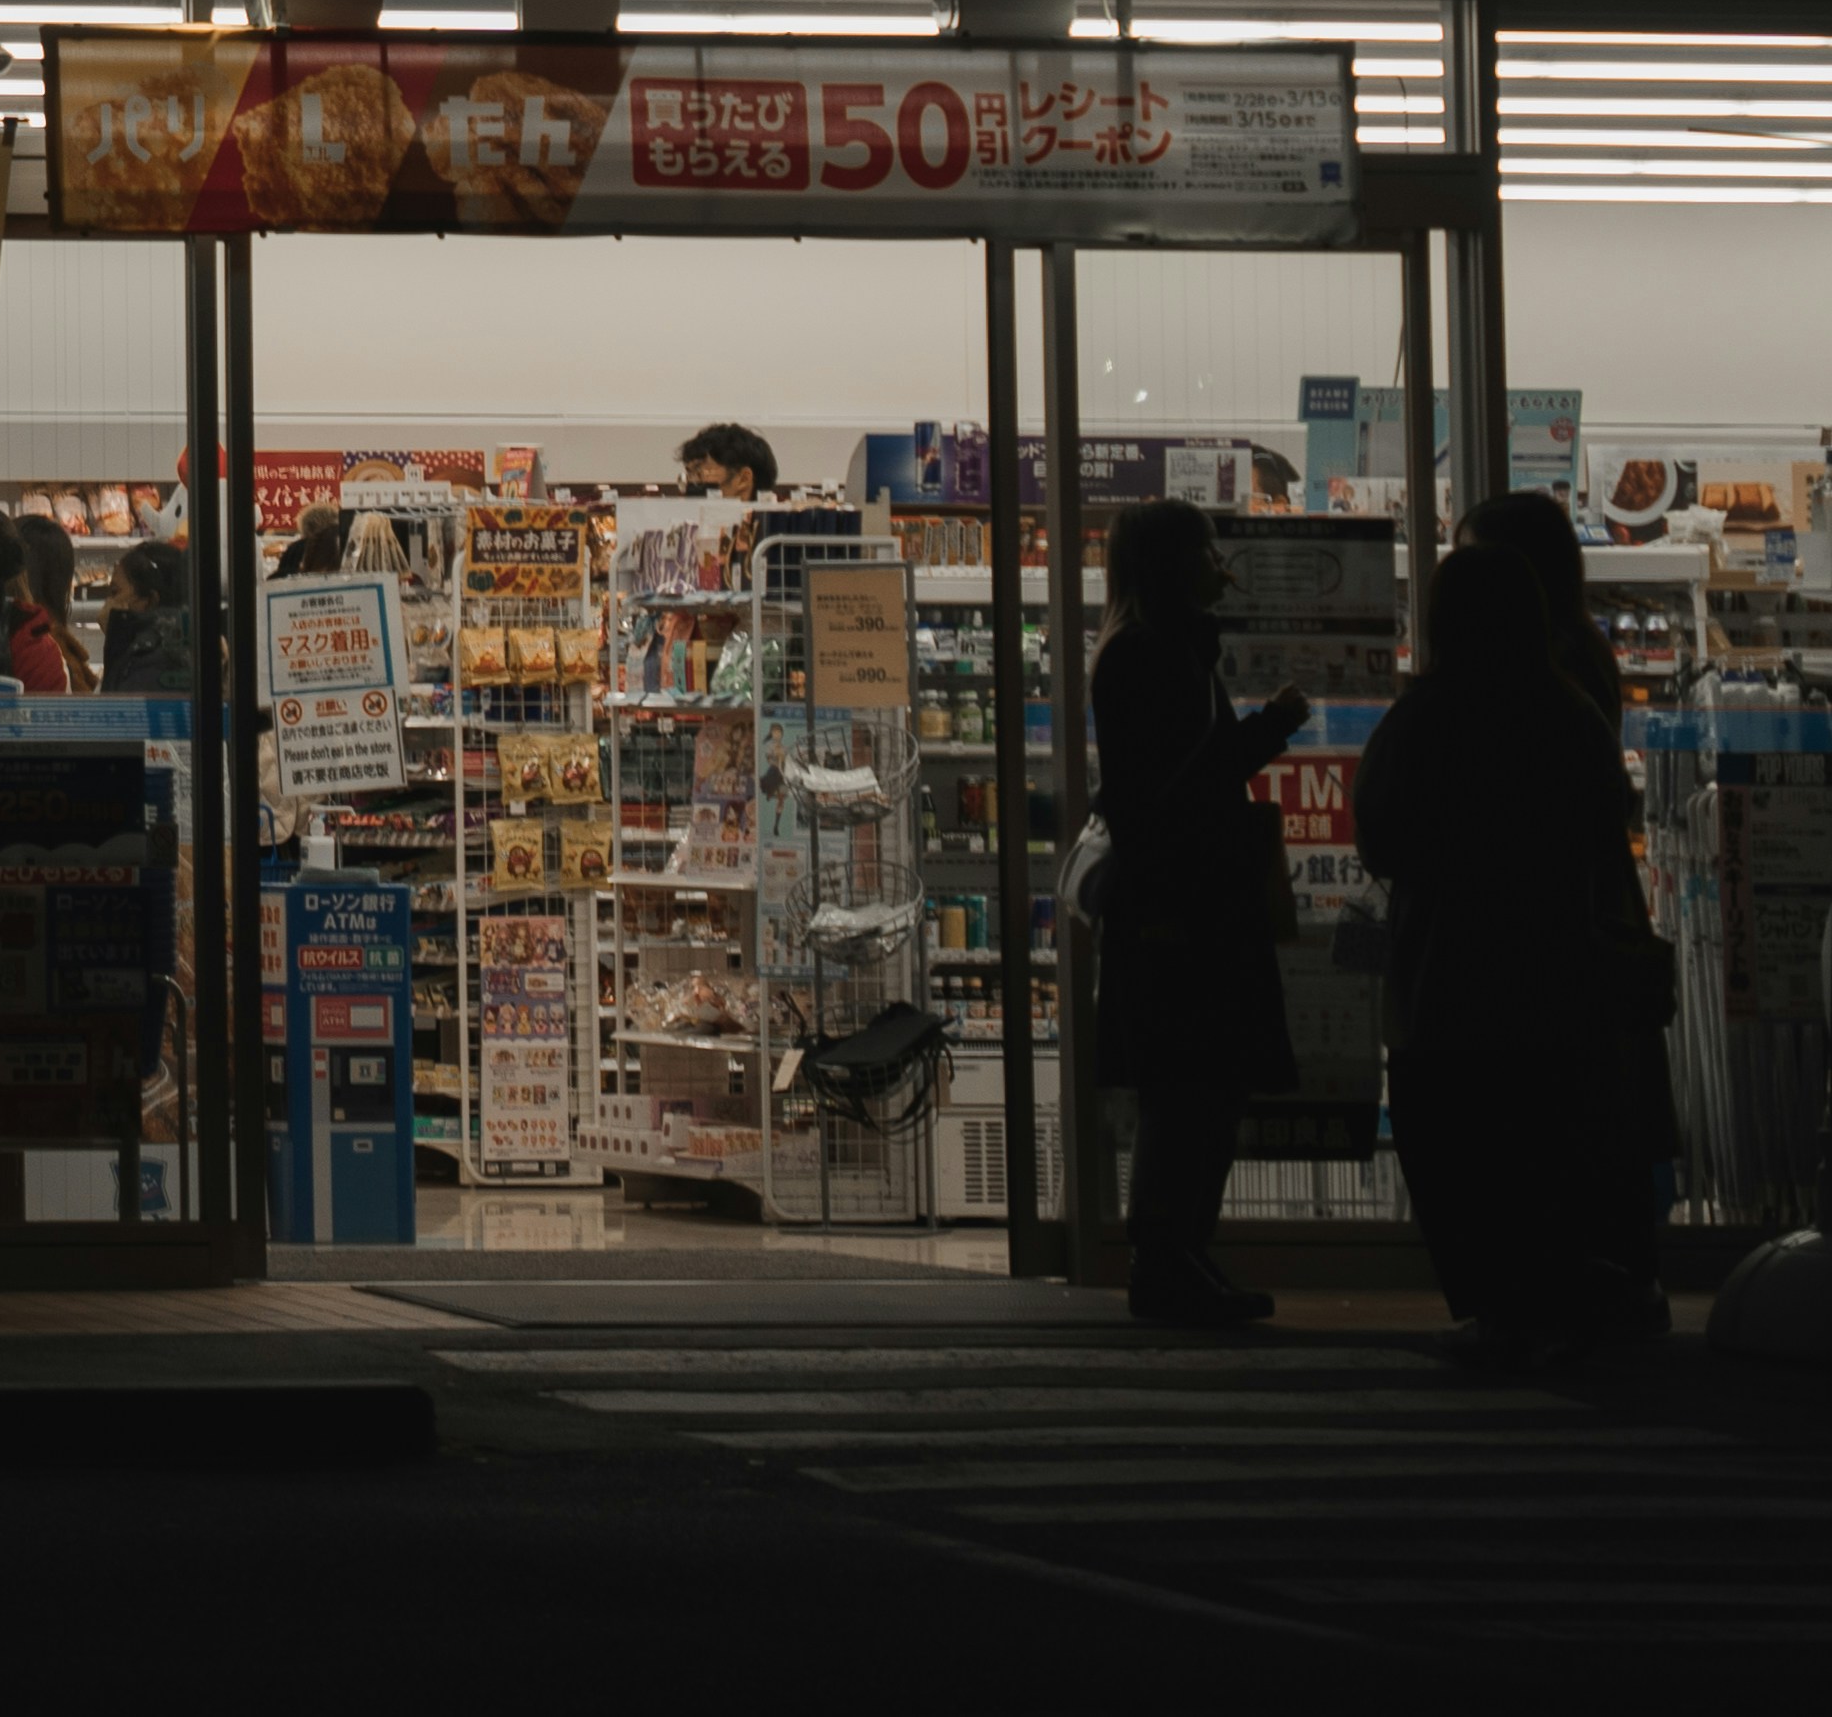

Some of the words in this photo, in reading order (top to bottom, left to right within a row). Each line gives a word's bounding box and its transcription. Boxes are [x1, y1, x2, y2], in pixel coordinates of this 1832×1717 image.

[645, 88, 792, 131] 買うたび
[1020, 81, 1169, 121] レシート
[87, 94, 204, 164] パリ
[439, 96, 576, 169] たん
[820, 81, 970, 191] 50
[1023, 124, 1172, 166] クーポン
[649, 138, 792, 177] もらえる
[1309, 388, 1349, 399] BEAMS
[1309, 401, 1349, 412] DESIGN
[476, 530, 576, 552] 素材のお菓子
[316, 699, 347, 712] お願い
[284, 749, 309, 764] Please
[311, 745, 331, 760] don't
[331, 747, 344, 759] eat
[346, 744, 353, 756] in
[355, 743, 368, 755] the
[370, 742, 394, 755] store.
[292, 762, 390, 785] 请不要在商店吃饭
[1283, 813, 1332, 840] 店舗
[304, 893, 396, 912] ローソン銀行
[324, 913, 377, 930] ATMは
[303, 950, 360, 966] 抗ウイルス
